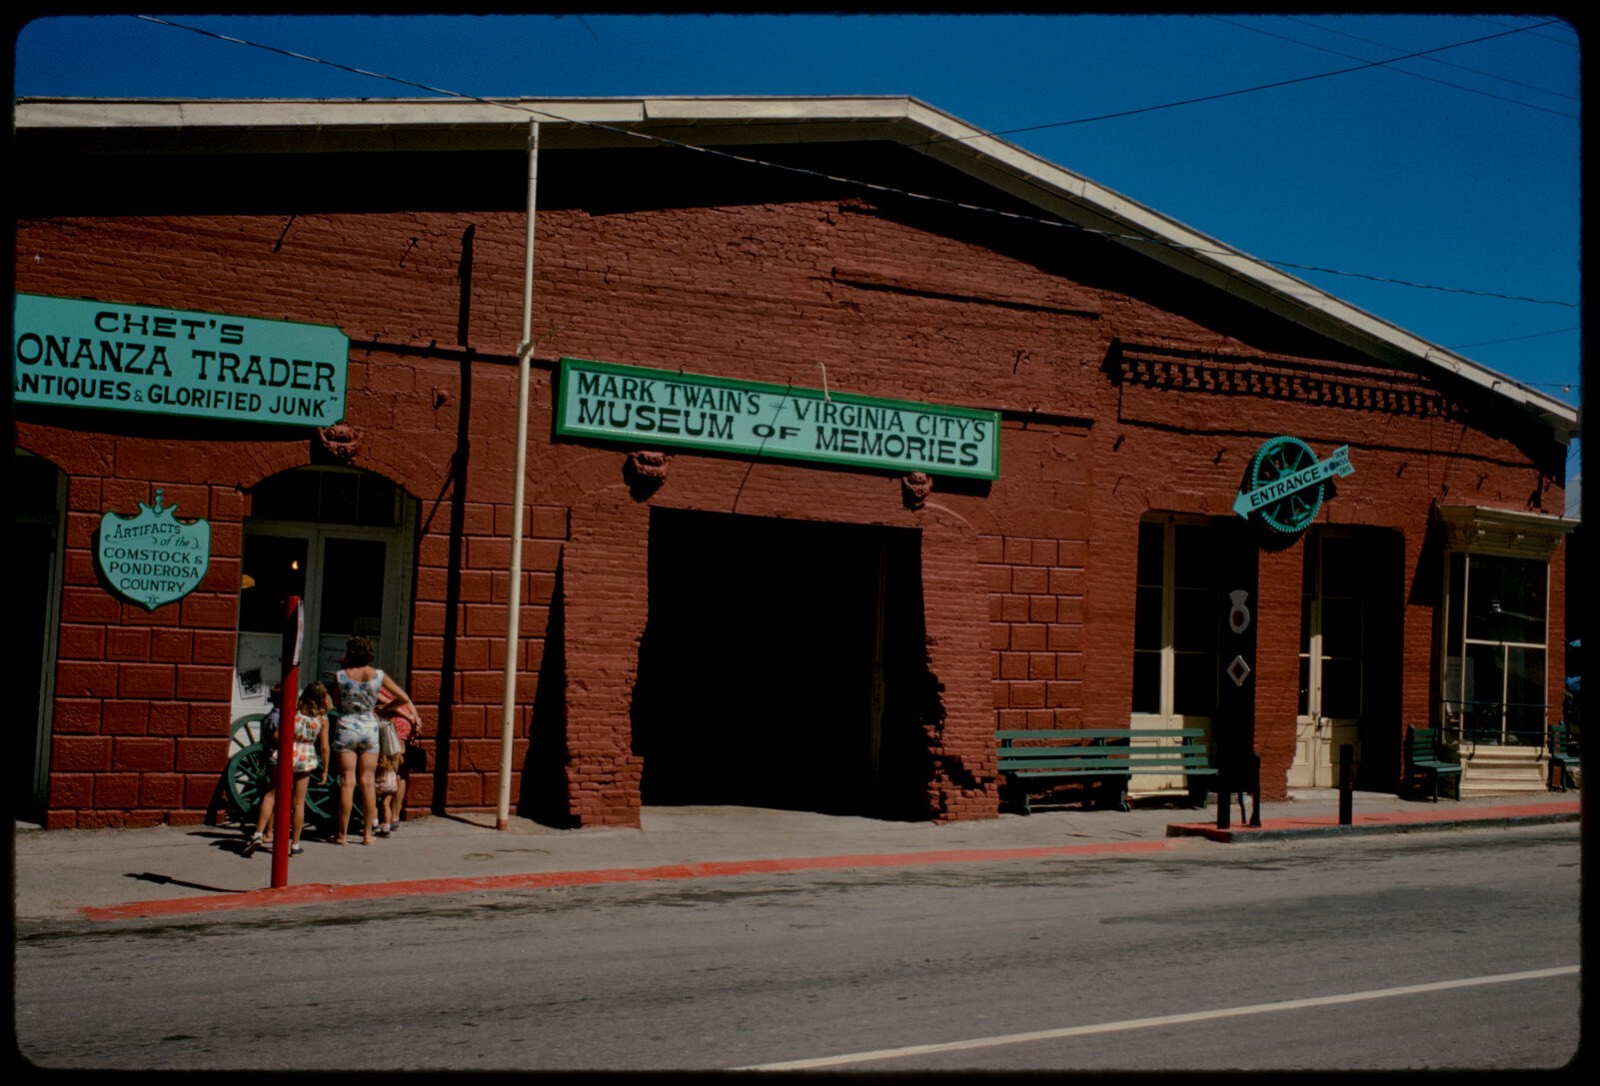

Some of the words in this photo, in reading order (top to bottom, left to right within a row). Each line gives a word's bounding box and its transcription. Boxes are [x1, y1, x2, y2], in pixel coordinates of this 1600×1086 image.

[95, 311, 244, 345] CHET'S
[192, 350, 336, 392] TRADER
[134, 389, 144, 402] &
[148, 384, 261, 412] GLORIFIED
[577, 372, 655, 401] MARK
[664, 383, 760, 415] TWAIN'S
[794, 399, 905, 432] VIRGINIA
[578, 399, 734, 440] MUSEUM
[752, 424, 801, 440] OF
[816, 426, 979, 467] MEMORIES
[1250, 467, 1320, 506] ENTRANCE
[113, 523, 181, 538] ARTIFACTS
[160, 535, 175, 547] of
[176, 536, 190, 547] the
[104, 547, 191, 564] COMSTOCK
[194, 556, 203, 564] &
[109, 561, 199, 578] PONDEROSA
[120, 578, 185, 593] COUNTRY
